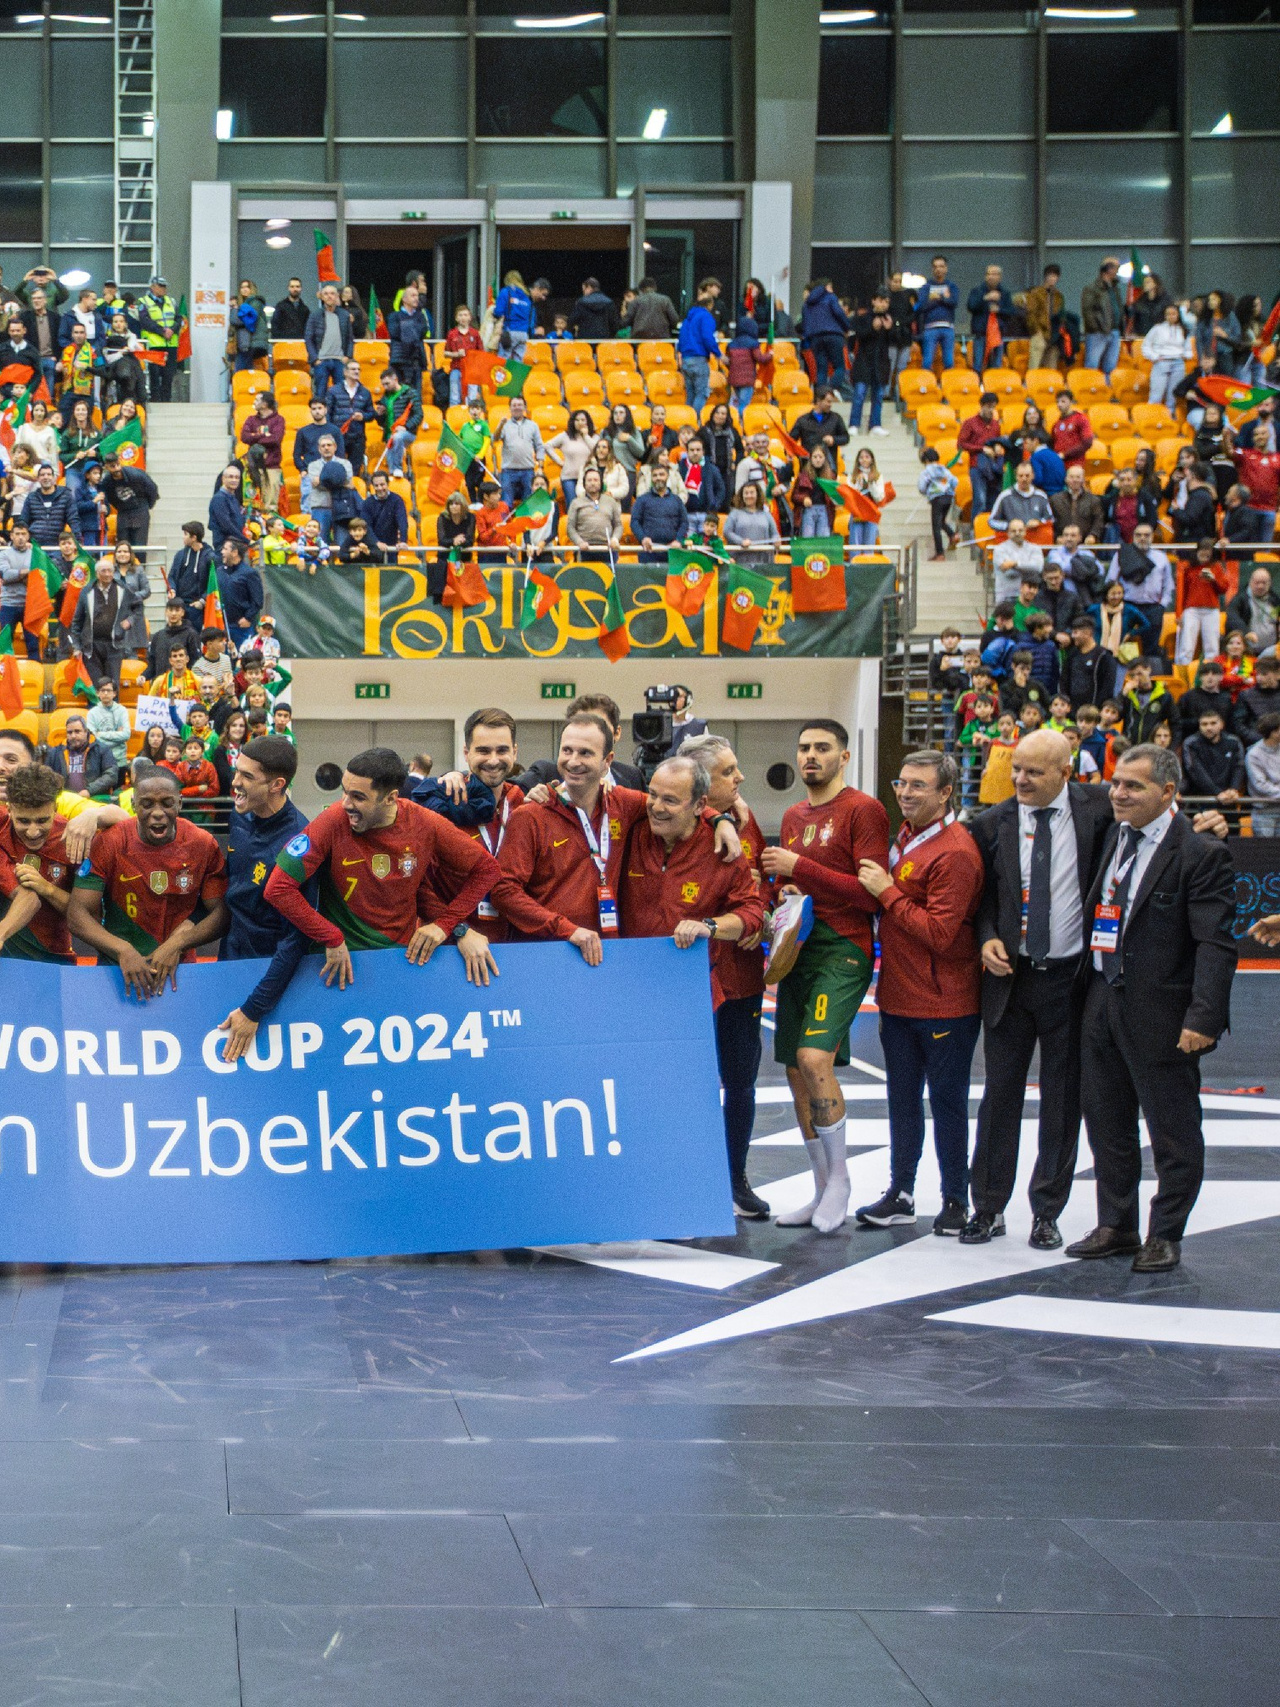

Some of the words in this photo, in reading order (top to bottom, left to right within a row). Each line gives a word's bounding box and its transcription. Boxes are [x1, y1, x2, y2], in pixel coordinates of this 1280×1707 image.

[343, 876, 358, 902] 7
[125, 892, 138, 918] 6
[814, 993, 829, 1021] 8
[201, 1022, 324, 1075] CUP
[75, 1078, 623, 1179] Uzbekistan!
